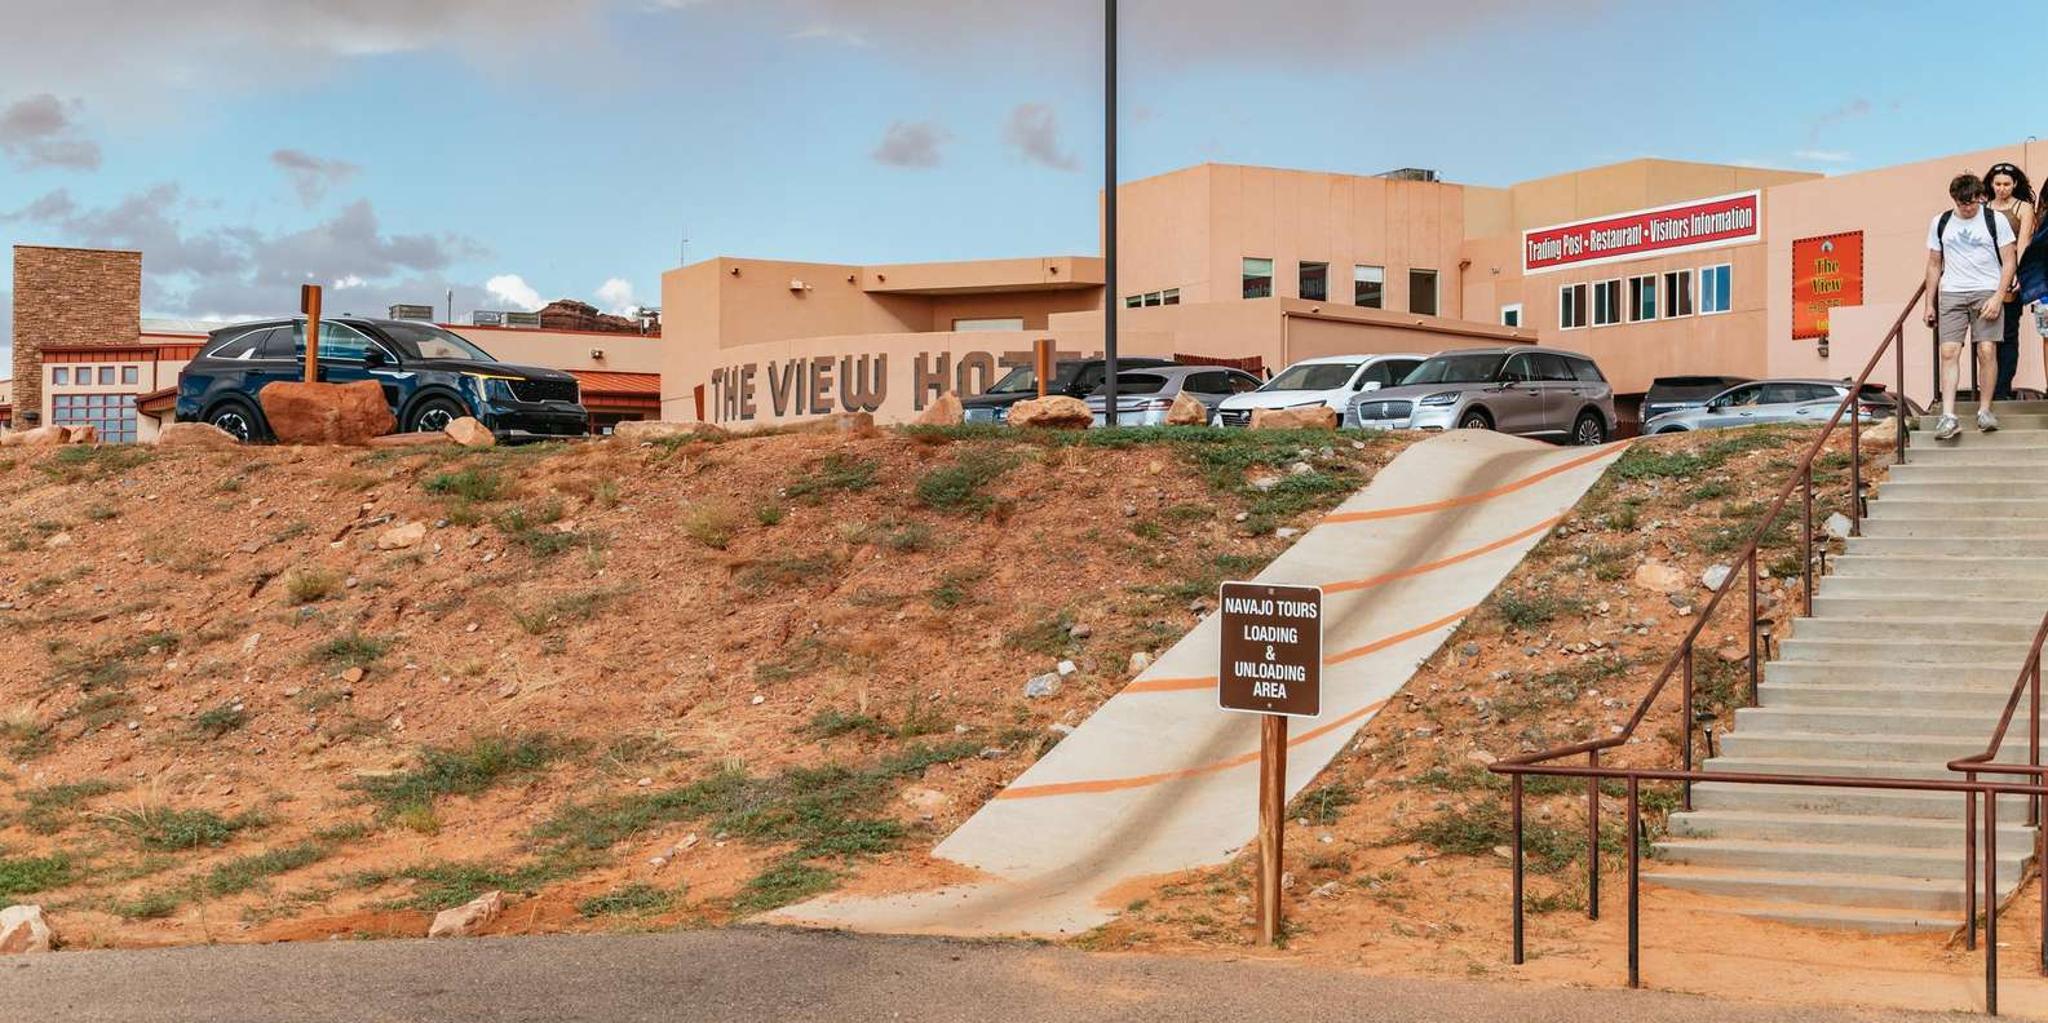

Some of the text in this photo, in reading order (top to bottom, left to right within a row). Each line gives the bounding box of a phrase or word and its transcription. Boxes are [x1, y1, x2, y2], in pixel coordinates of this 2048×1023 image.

[1528, 206, 1752, 261] Trading Post Restaurant Visitors Information
[1814, 257, 1840, 276] The
[1811, 277, 1842, 295] View
[712, 363, 757, 424] THE
[768, 353, 887, 417] VIEW
[1225, 598, 1317, 619] NAVAJO TOURS
[1244, 624, 1298, 643] LOADING
[1265, 645, 1276, 661] &
[1235, 661, 1306, 682] UNLOADING
[1253, 681, 1287, 699] AREA
